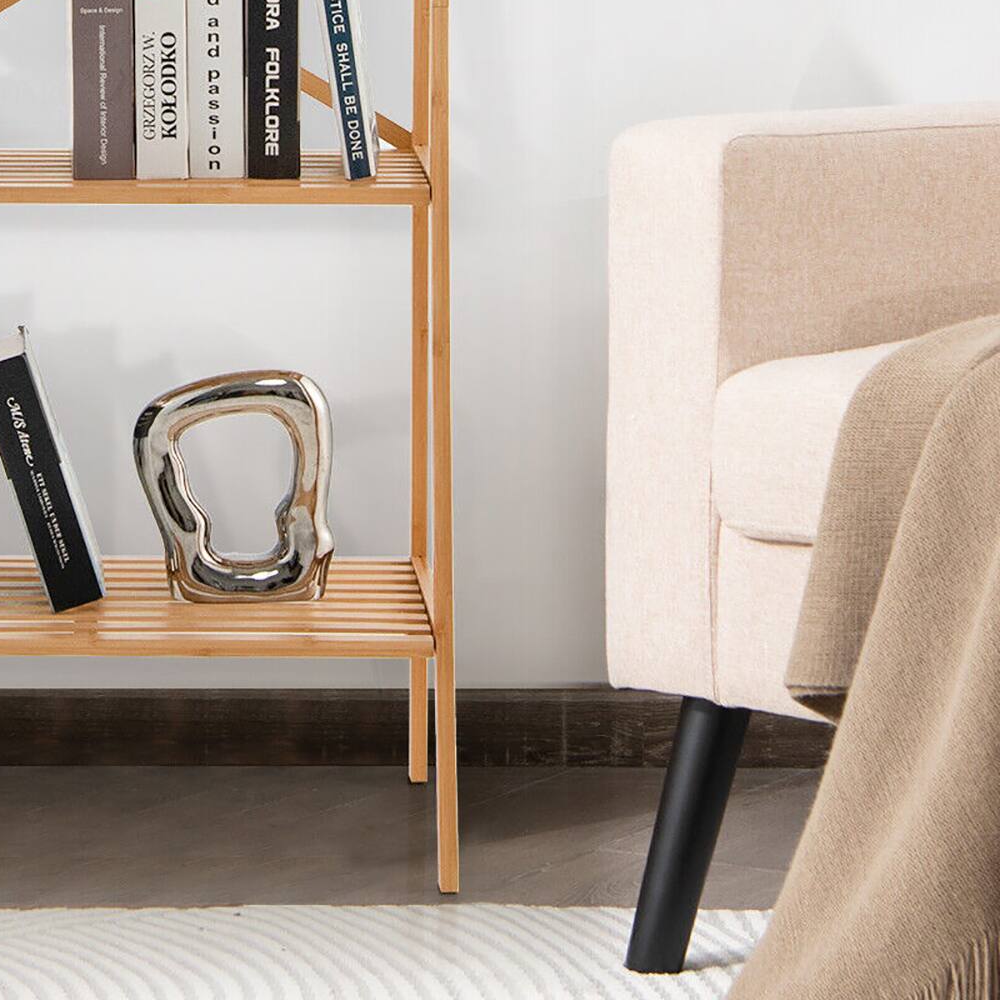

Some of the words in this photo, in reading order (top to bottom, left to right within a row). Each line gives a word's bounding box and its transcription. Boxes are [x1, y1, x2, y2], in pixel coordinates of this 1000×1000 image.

[208, 17, 220, 58] and
[160, 31, 177, 139] KOŁODKO
[336, 42, 353, 91] SHALL
[143, 54, 156, 141] GRZEGORZ
[208, 69, 221, 170] passion
[264, 47, 280, 156] FOLKLORE
[343, 96, 357, 115] BE
[99, 138, 109, 166] Design
[348, 120, 364, 161] DONE
